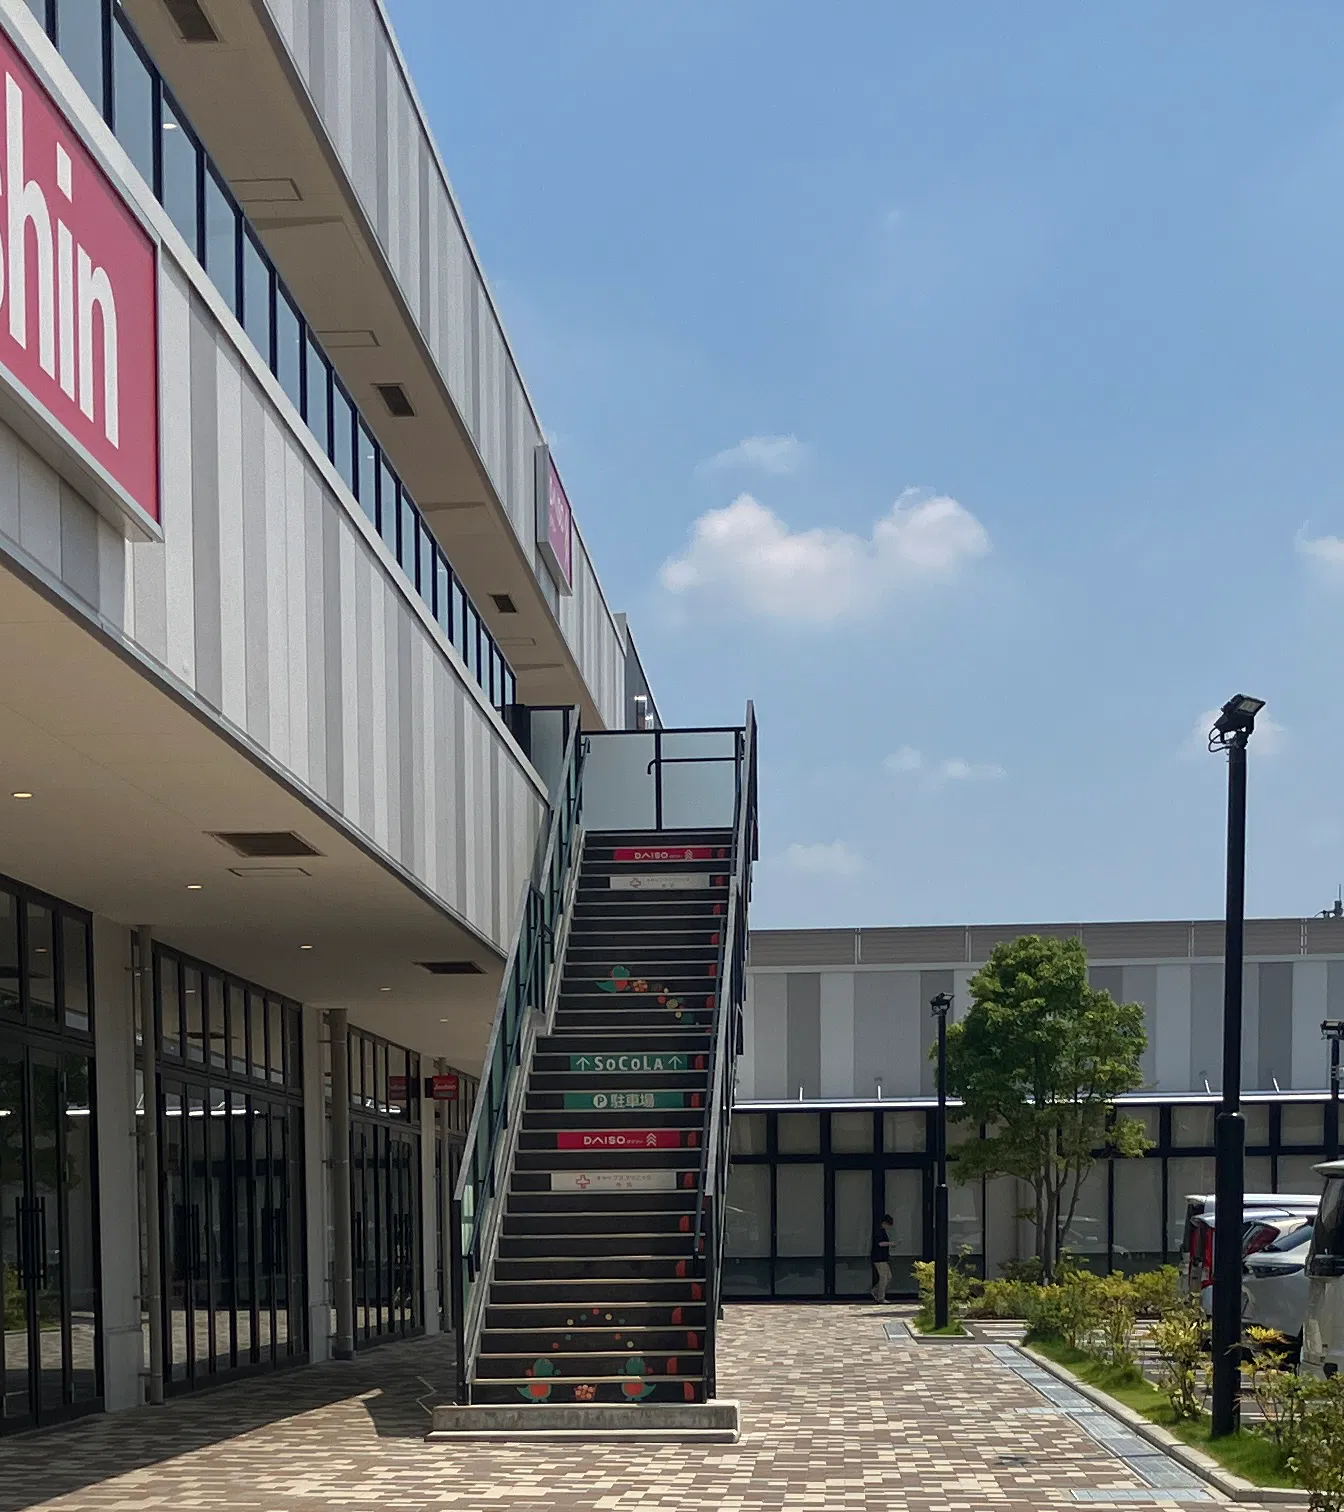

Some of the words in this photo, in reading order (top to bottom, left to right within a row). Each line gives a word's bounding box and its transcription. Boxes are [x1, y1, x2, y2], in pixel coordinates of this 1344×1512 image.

[610, 1093, 655, 1108] 駐車場
[583, 1135, 626, 1145] DAISO
